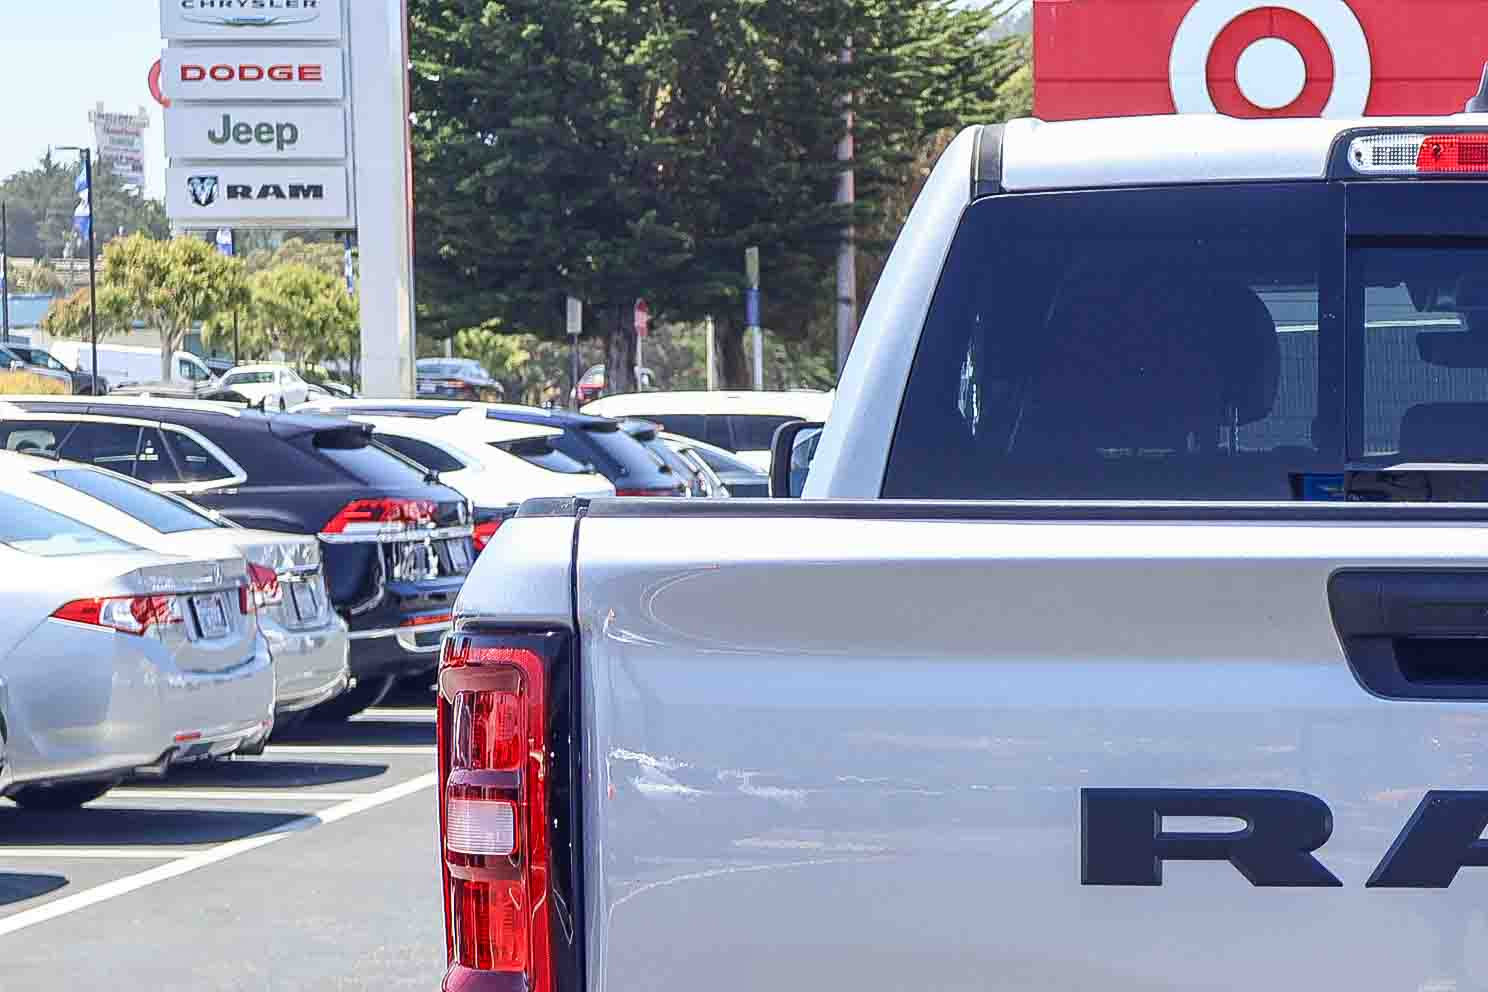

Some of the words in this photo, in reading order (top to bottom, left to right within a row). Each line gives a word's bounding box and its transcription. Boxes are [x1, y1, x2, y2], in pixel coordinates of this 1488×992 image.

[180, 64, 323, 81] DODGE
[208, 114, 298, 151] Jeep
[227, 184, 323, 200] RAM
